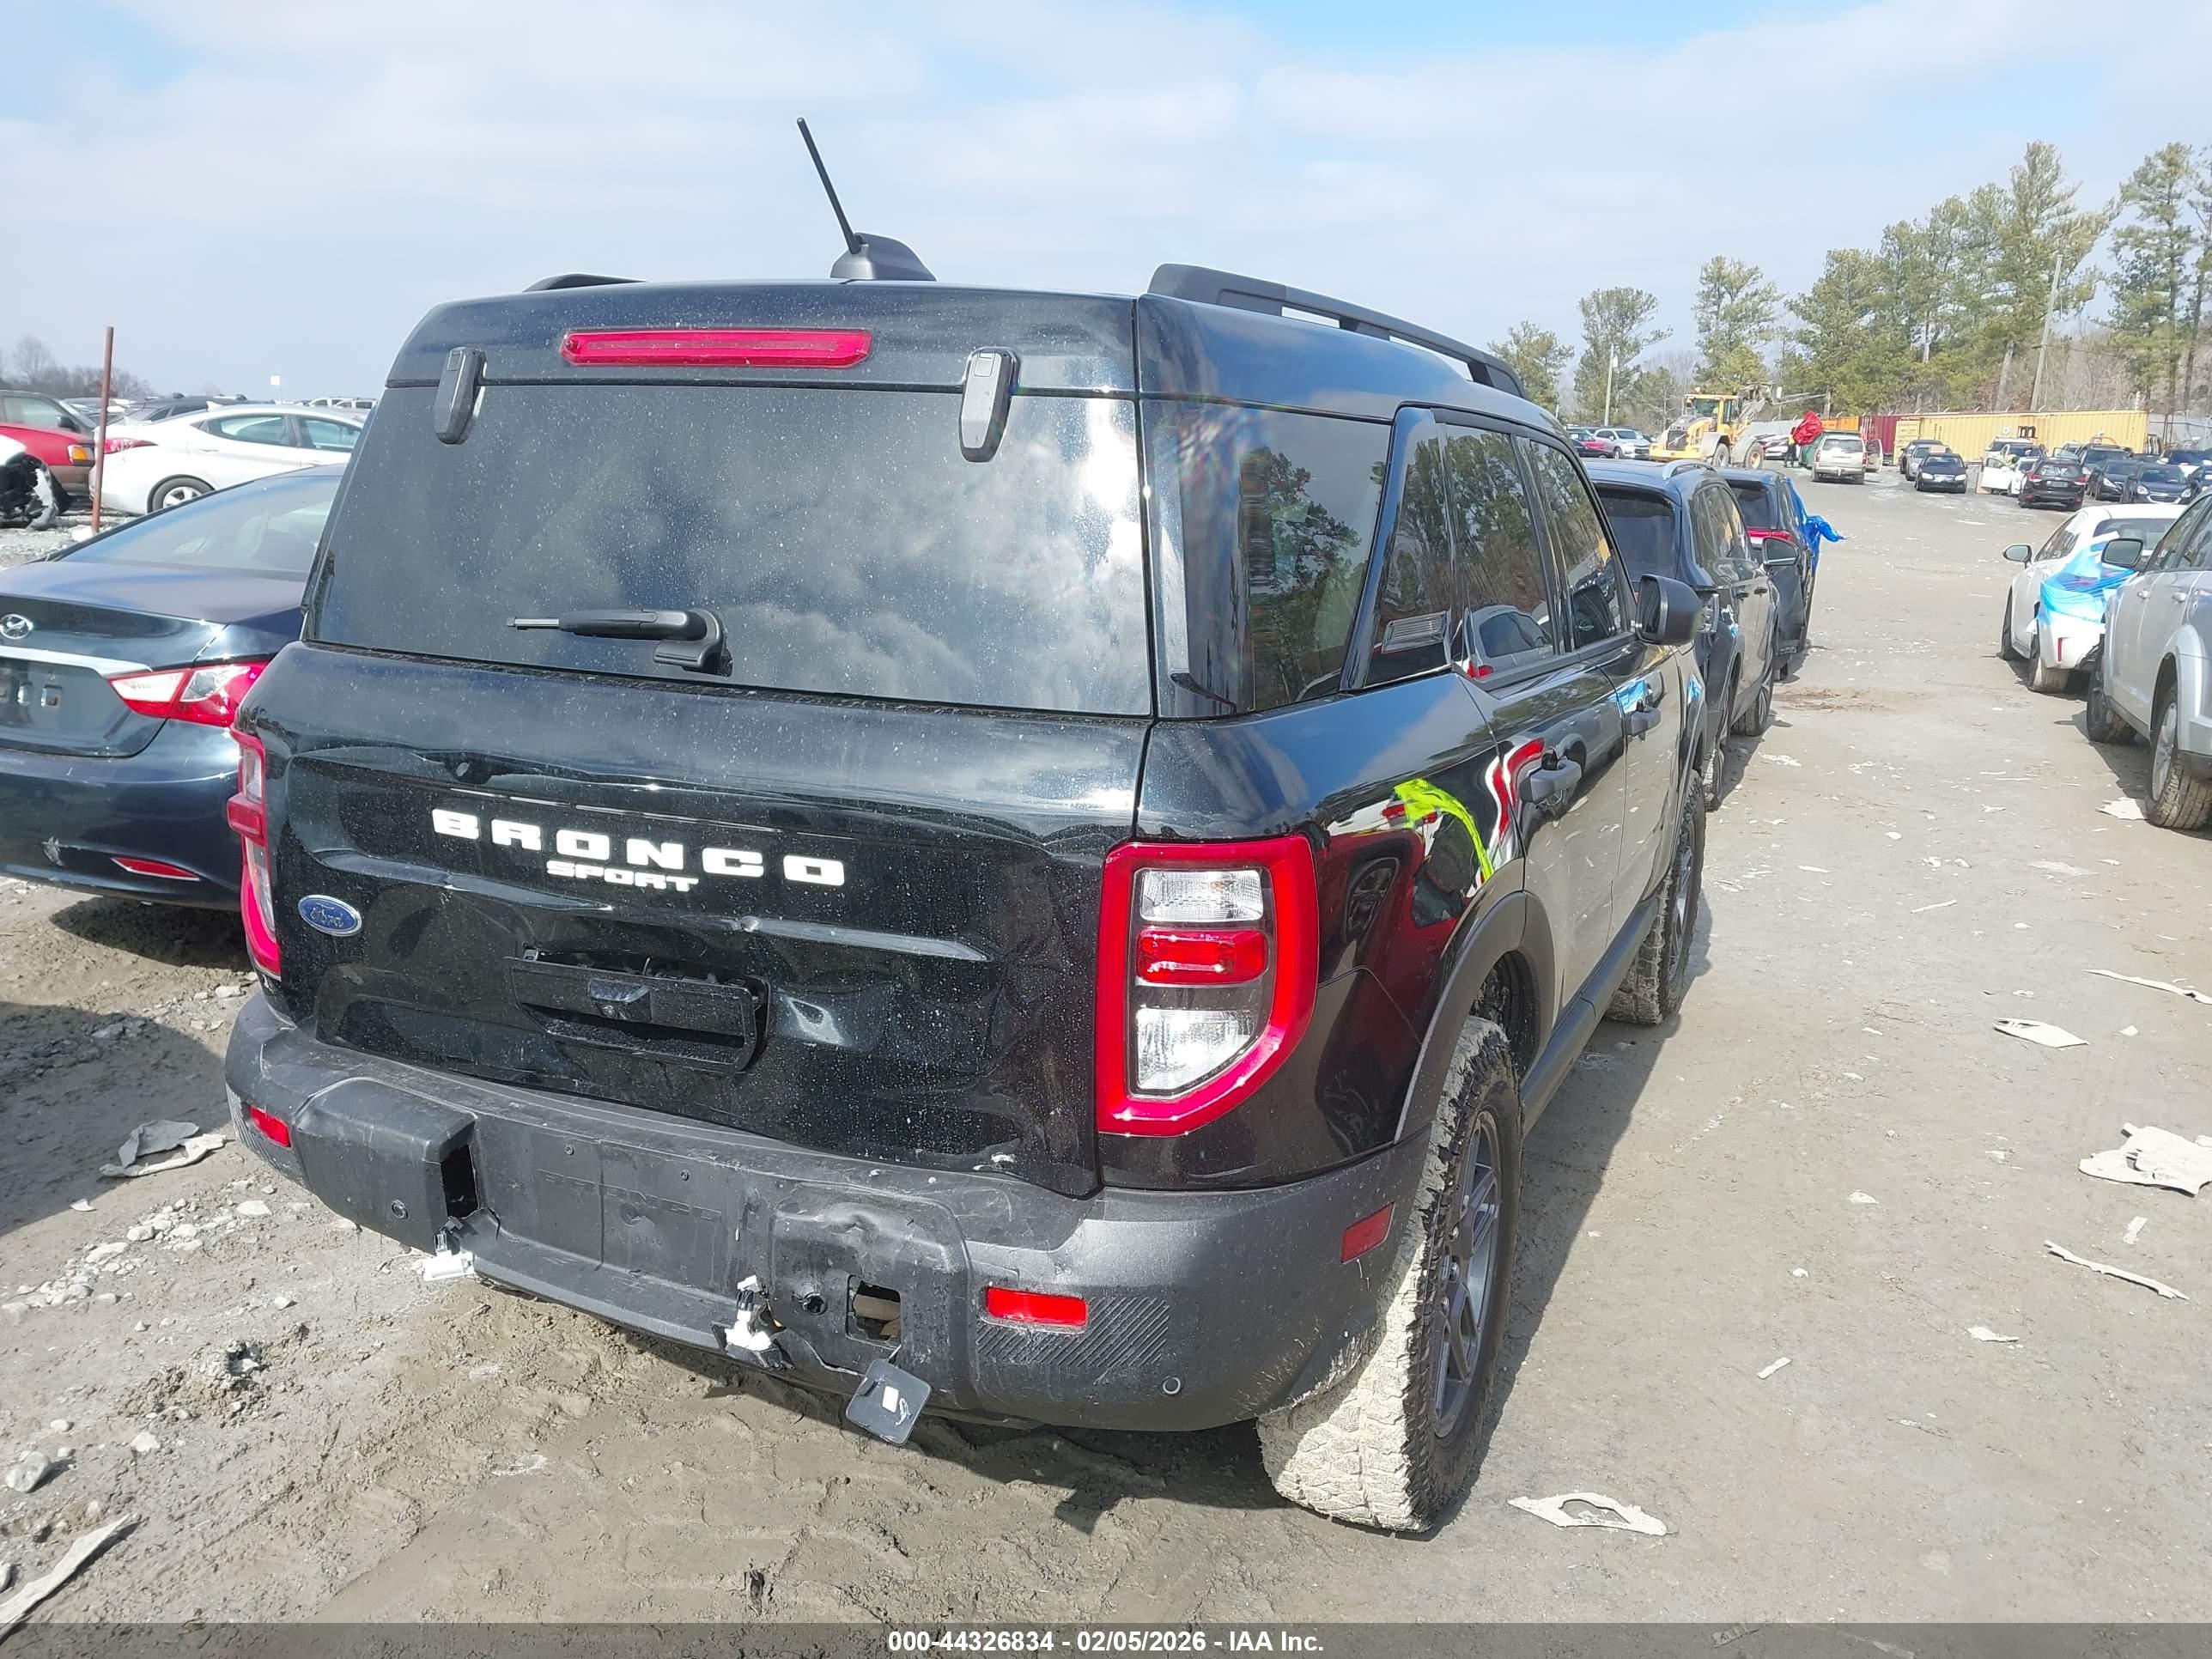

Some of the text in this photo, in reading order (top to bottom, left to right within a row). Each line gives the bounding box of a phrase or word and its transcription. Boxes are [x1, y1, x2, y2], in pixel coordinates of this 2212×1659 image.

[431, 807, 846, 887] BRONCO
[545, 860, 699, 892] SPORT
[309, 902, 345, 928] Ford
